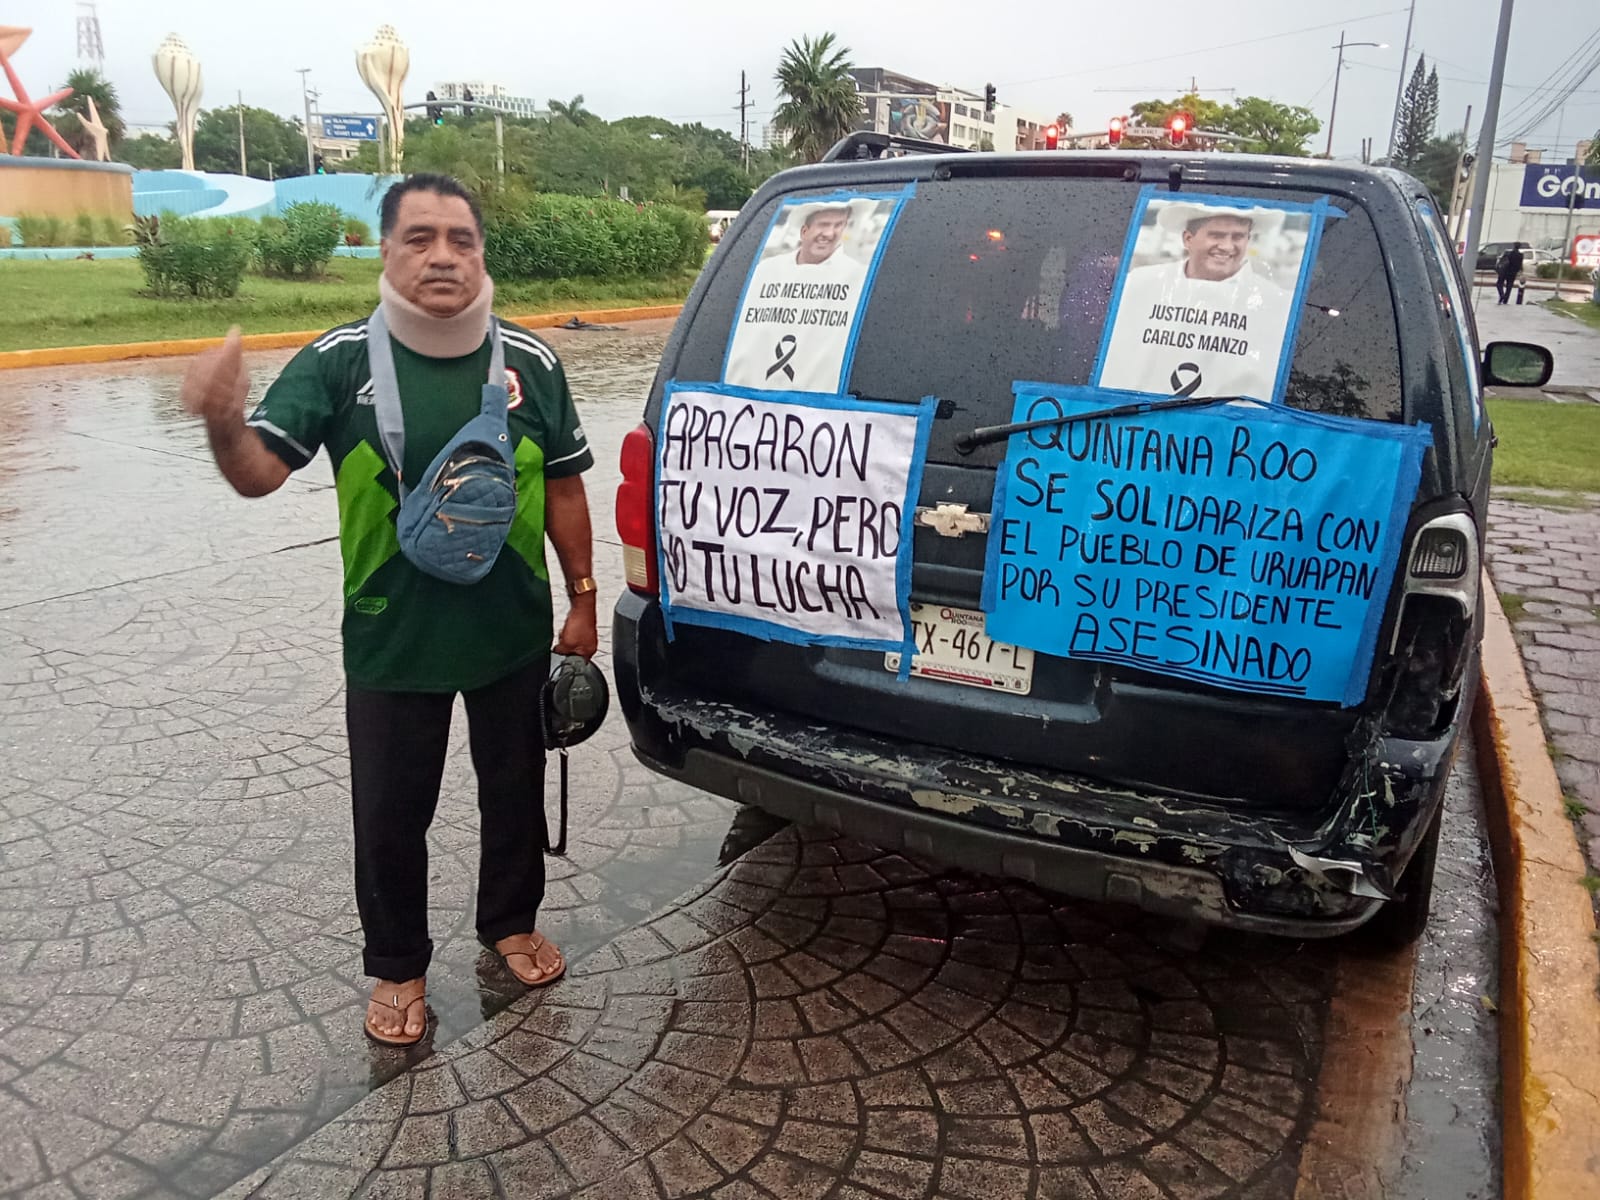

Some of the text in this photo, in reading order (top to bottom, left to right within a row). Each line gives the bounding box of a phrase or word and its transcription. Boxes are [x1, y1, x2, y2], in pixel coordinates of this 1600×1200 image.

[745, 307, 849, 328] EXIGIMOS JUSTICIA
[760, 283, 849, 301] LOS MEXICANOS
[1149, 304, 1248, 331] JUSTICIA PARA
[1142, 328, 1249, 356] CARLOS MANZO
[662, 402, 872, 481] APAGARON
[1026, 396, 1318, 482] QUINTANA ROO
[658, 480, 901, 559] TU VOZ, PERO
[1016, 457, 1380, 554] SE SOLIDARIZA CON
[692, 541, 740, 604] TU
[1000, 519, 1379, 600] EL PUEBLO DE URUAPAN
[940, 608, 984, 622] QUINTANA
[1001, 563, 1342, 629] POR SU PRESIDENTE
[1069, 612, 1311, 682] ASESINADO
